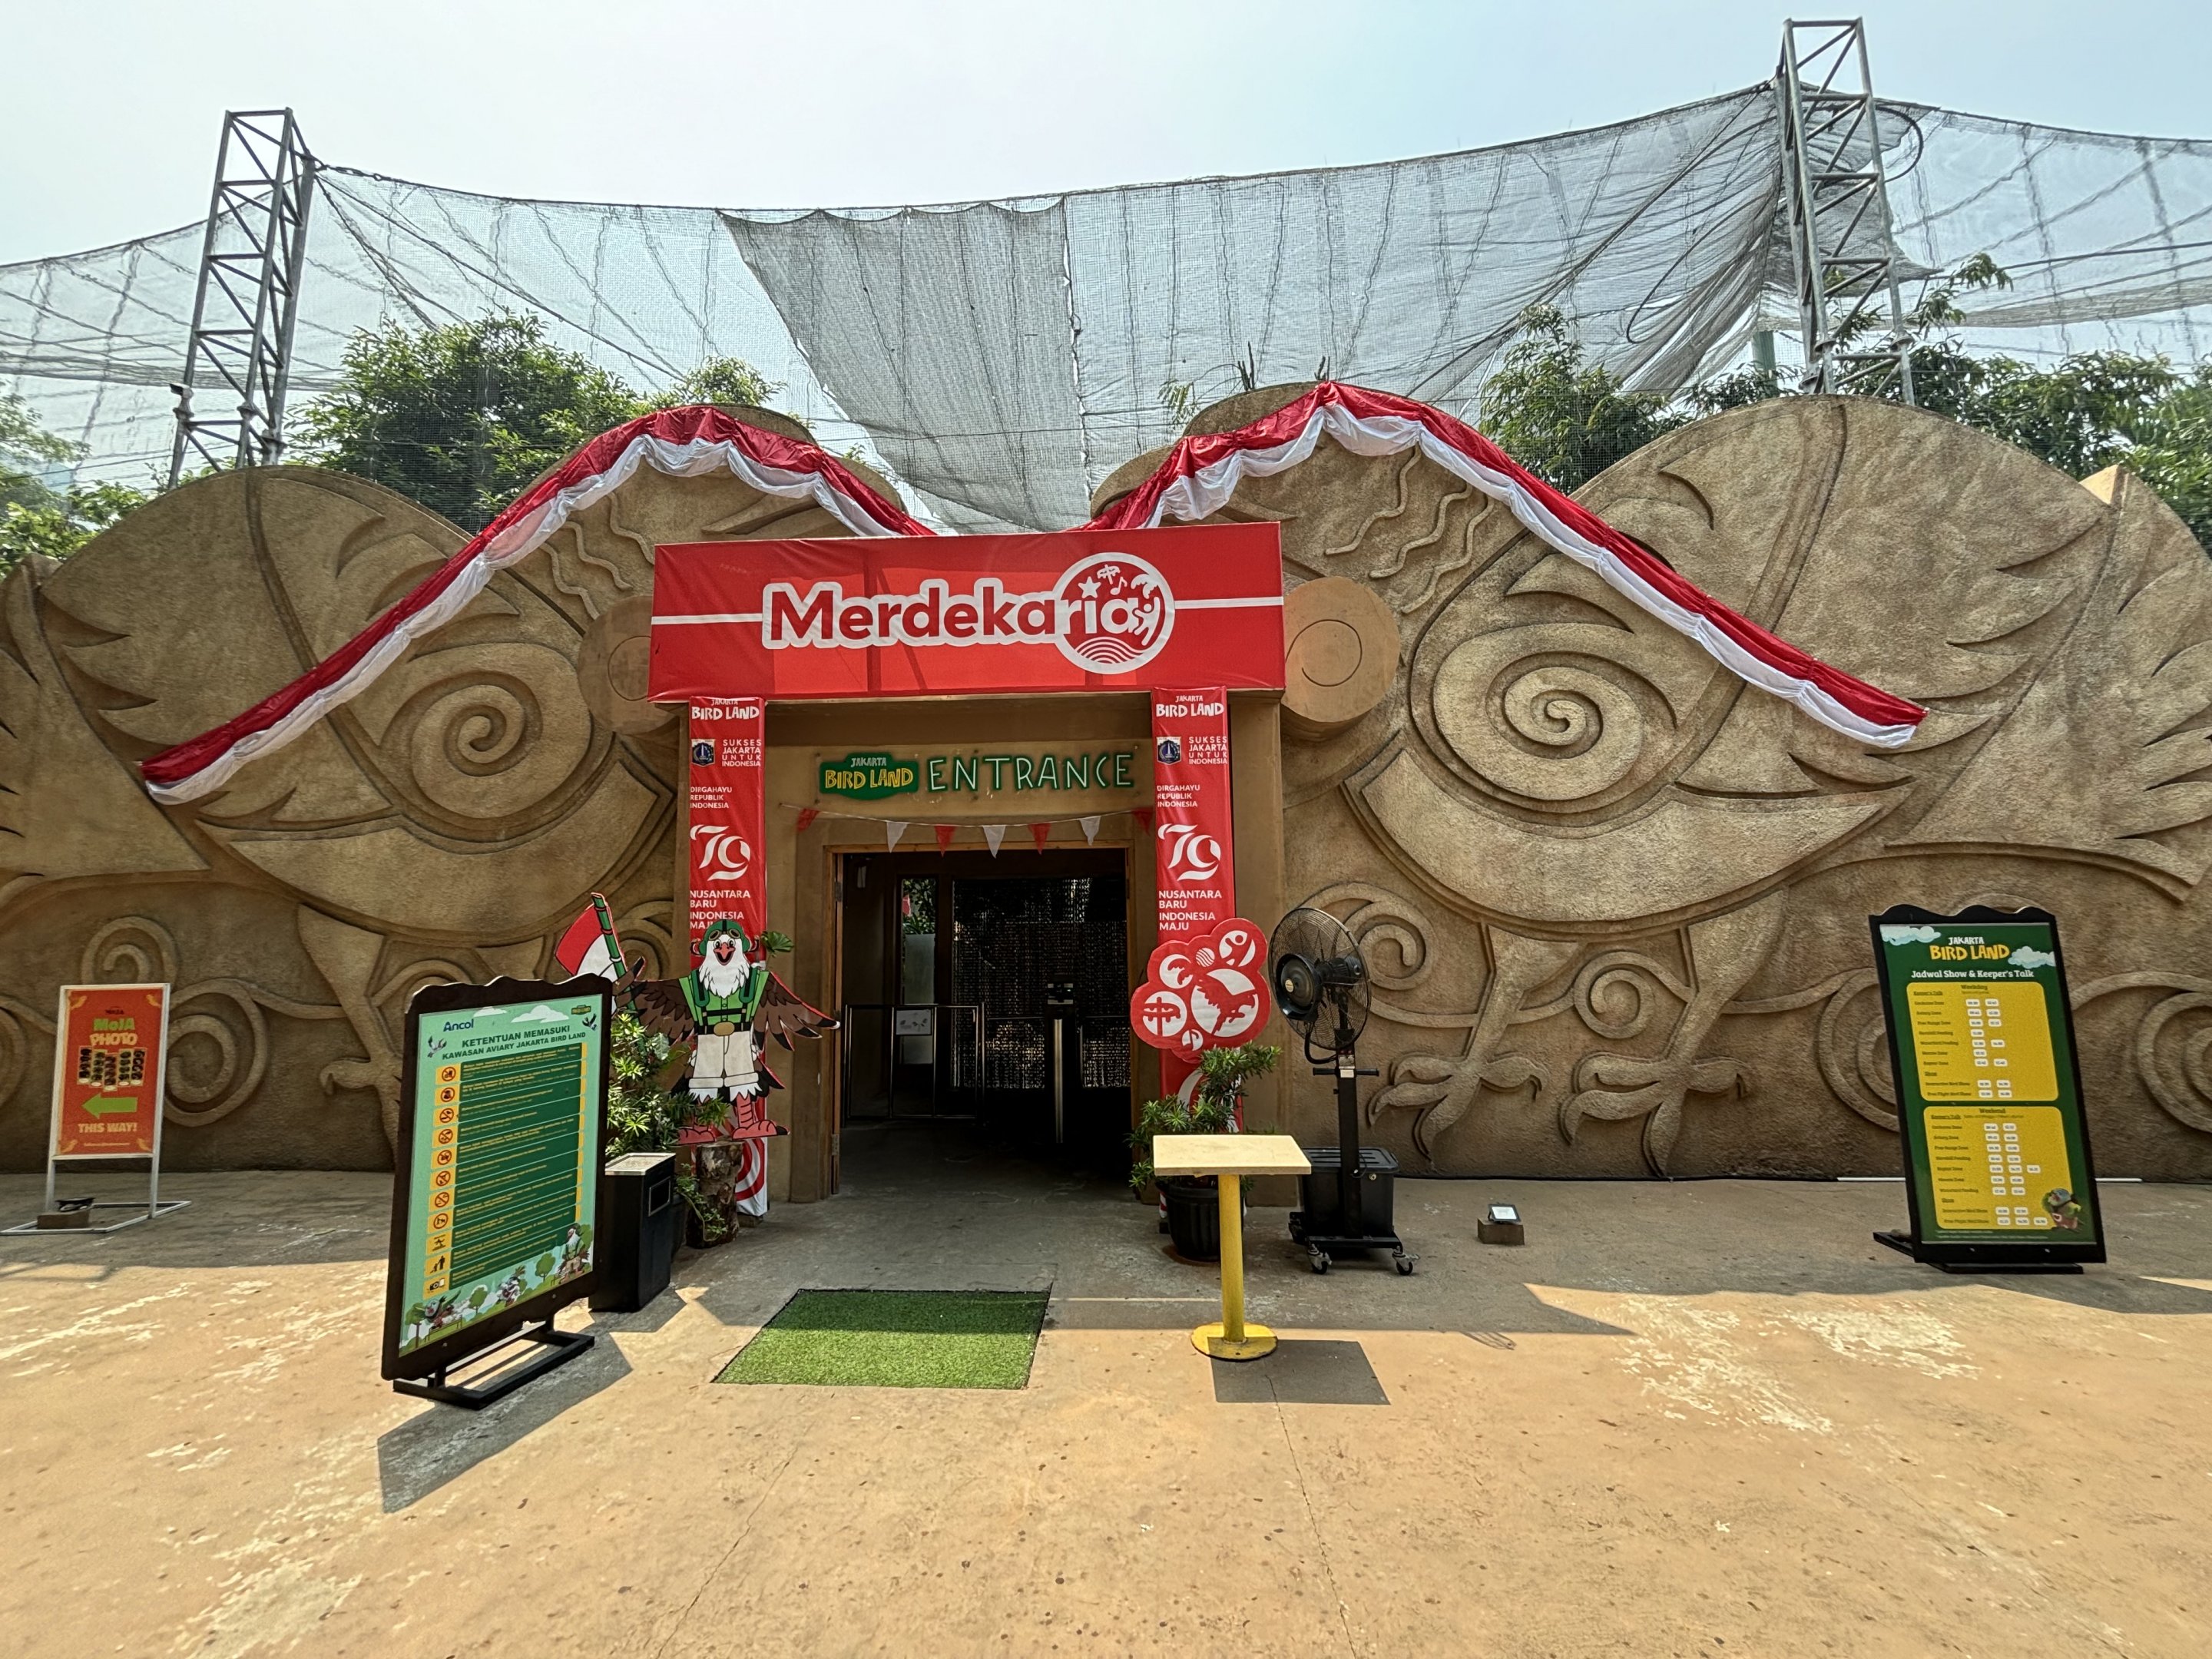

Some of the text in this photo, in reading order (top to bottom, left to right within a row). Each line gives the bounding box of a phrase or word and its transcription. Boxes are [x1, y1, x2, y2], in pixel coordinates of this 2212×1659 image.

[767, 581, 1159, 644] Merdekaria
[691, 706, 760, 720] BIRD LAND
[1156, 702, 1224, 717] BIRD LAND
[851, 757, 886, 767] JAKARTA
[825, 767, 913, 790] BIRD LAND
[929, 754, 1131, 791] ENTRANCE
[690, 824, 750, 881] 79
[1157, 823, 1221, 881] 79
[1158, 890, 1222, 899] NUSANTARA
[690, 899, 717, 908] BARU
[1159, 900, 1187, 909] BARU
[1948, 936, 1985, 945] JAKARTA
[1929, 944, 2010, 960] BIRD LAND
[1976, 970, 2013, 979] Keeper's
[443, 1018, 474, 1032] Ancol
[90, 1032, 138, 1045] PHOTO
[462, 1025, 570, 1048] KETENTUAN MEMASUKI
[442, 1031, 586, 1060] KAWASAN AVIARY JAKARTA BIRD LAND
[78, 1122, 137, 1133] THIS WAY!
